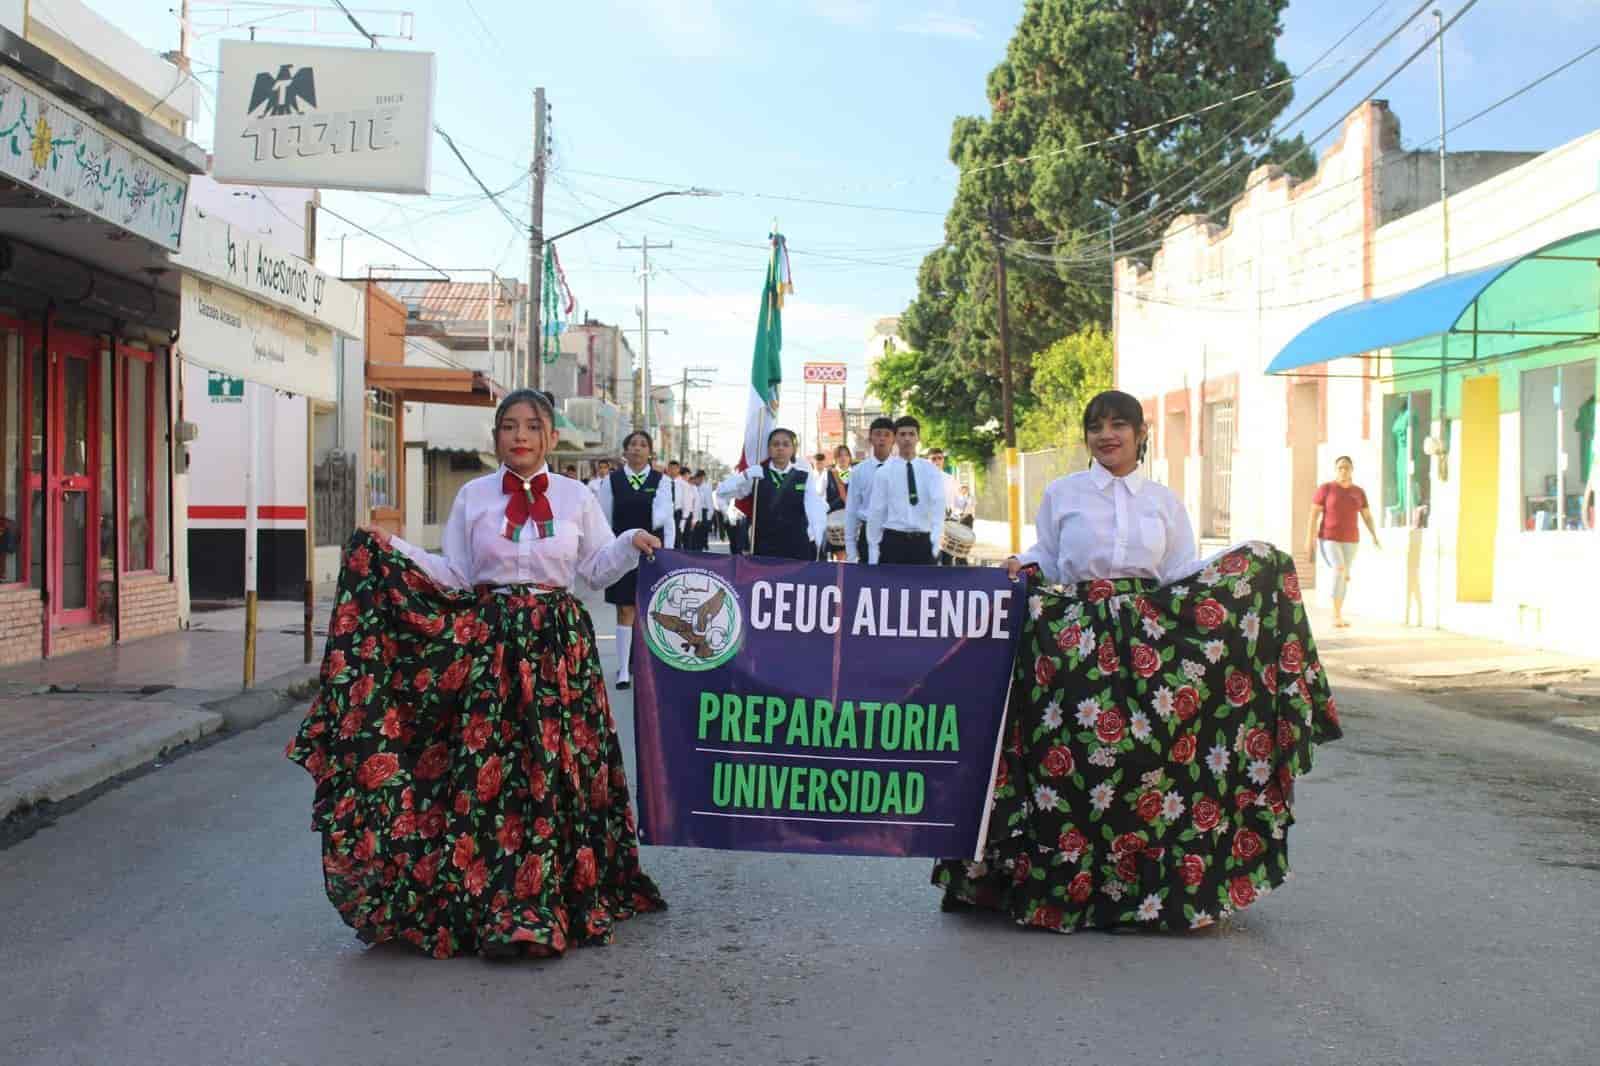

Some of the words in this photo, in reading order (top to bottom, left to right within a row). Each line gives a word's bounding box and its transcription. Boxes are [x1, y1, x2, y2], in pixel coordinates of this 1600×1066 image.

[804, 366, 847, 381] OXXO
[750, 580, 842, 634] CEUC
[851, 587, 1012, 640] ALLENDE
[697, 691, 960, 752] PREPARATORIA
[712, 762, 926, 815] UNIVERSIDAD
